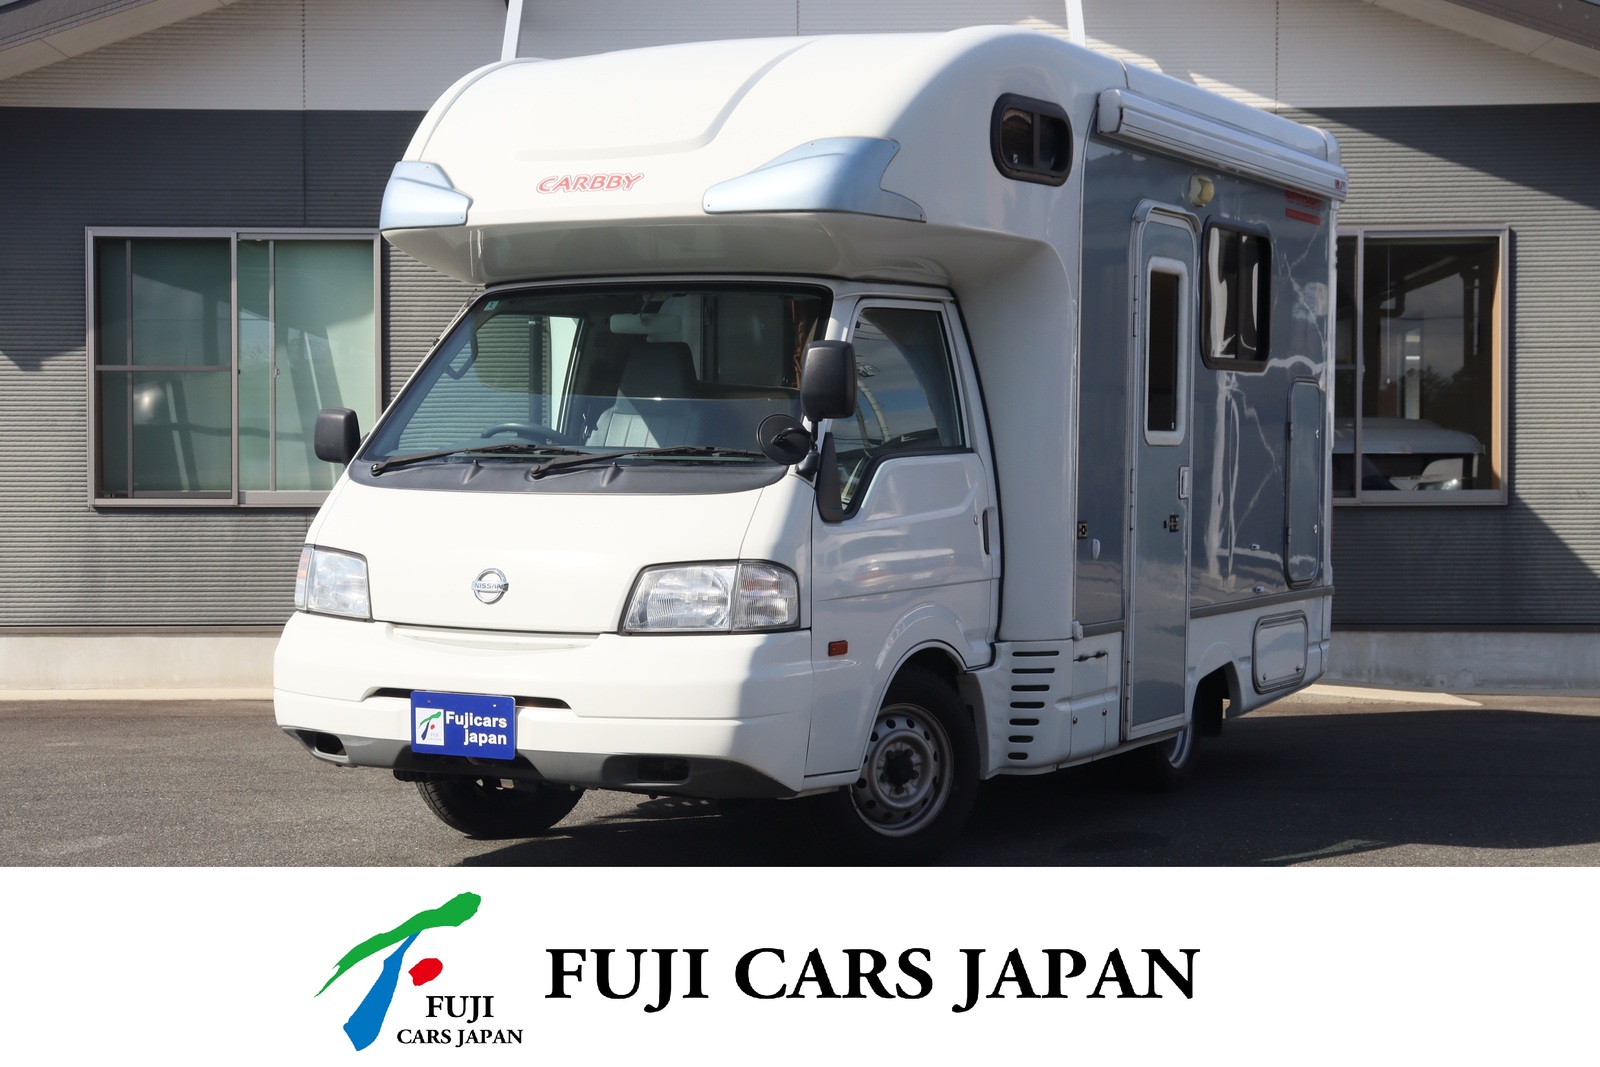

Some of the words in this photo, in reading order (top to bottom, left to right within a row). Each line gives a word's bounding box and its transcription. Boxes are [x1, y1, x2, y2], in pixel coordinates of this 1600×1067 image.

[536, 173, 645, 194] CARBBY
[474, 582, 504, 590] NISSAN
[445, 710, 508, 729] Fujicars
[463, 728, 507, 746] japan
